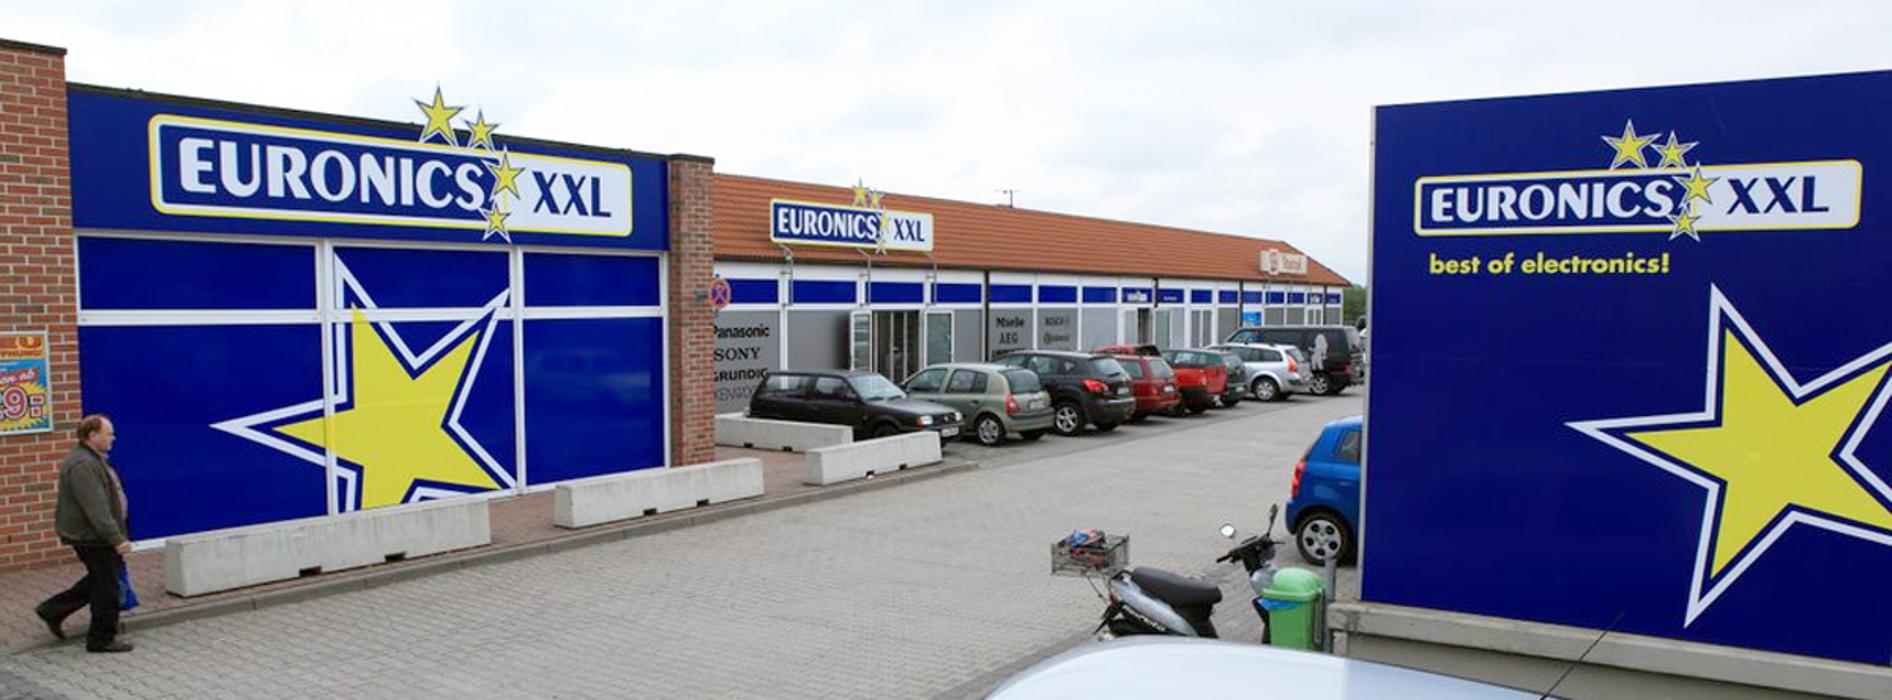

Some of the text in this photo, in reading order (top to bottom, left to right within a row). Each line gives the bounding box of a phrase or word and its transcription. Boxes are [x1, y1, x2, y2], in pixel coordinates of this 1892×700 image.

[179, 137, 612, 218] EURONICS XXL
[1431, 175, 1830, 222] EURONICS XXL
[778, 207, 925, 242] EURONICS XXL
[1429, 252, 1670, 274] best of electronics!
[713, 347, 760, 361] SONY
